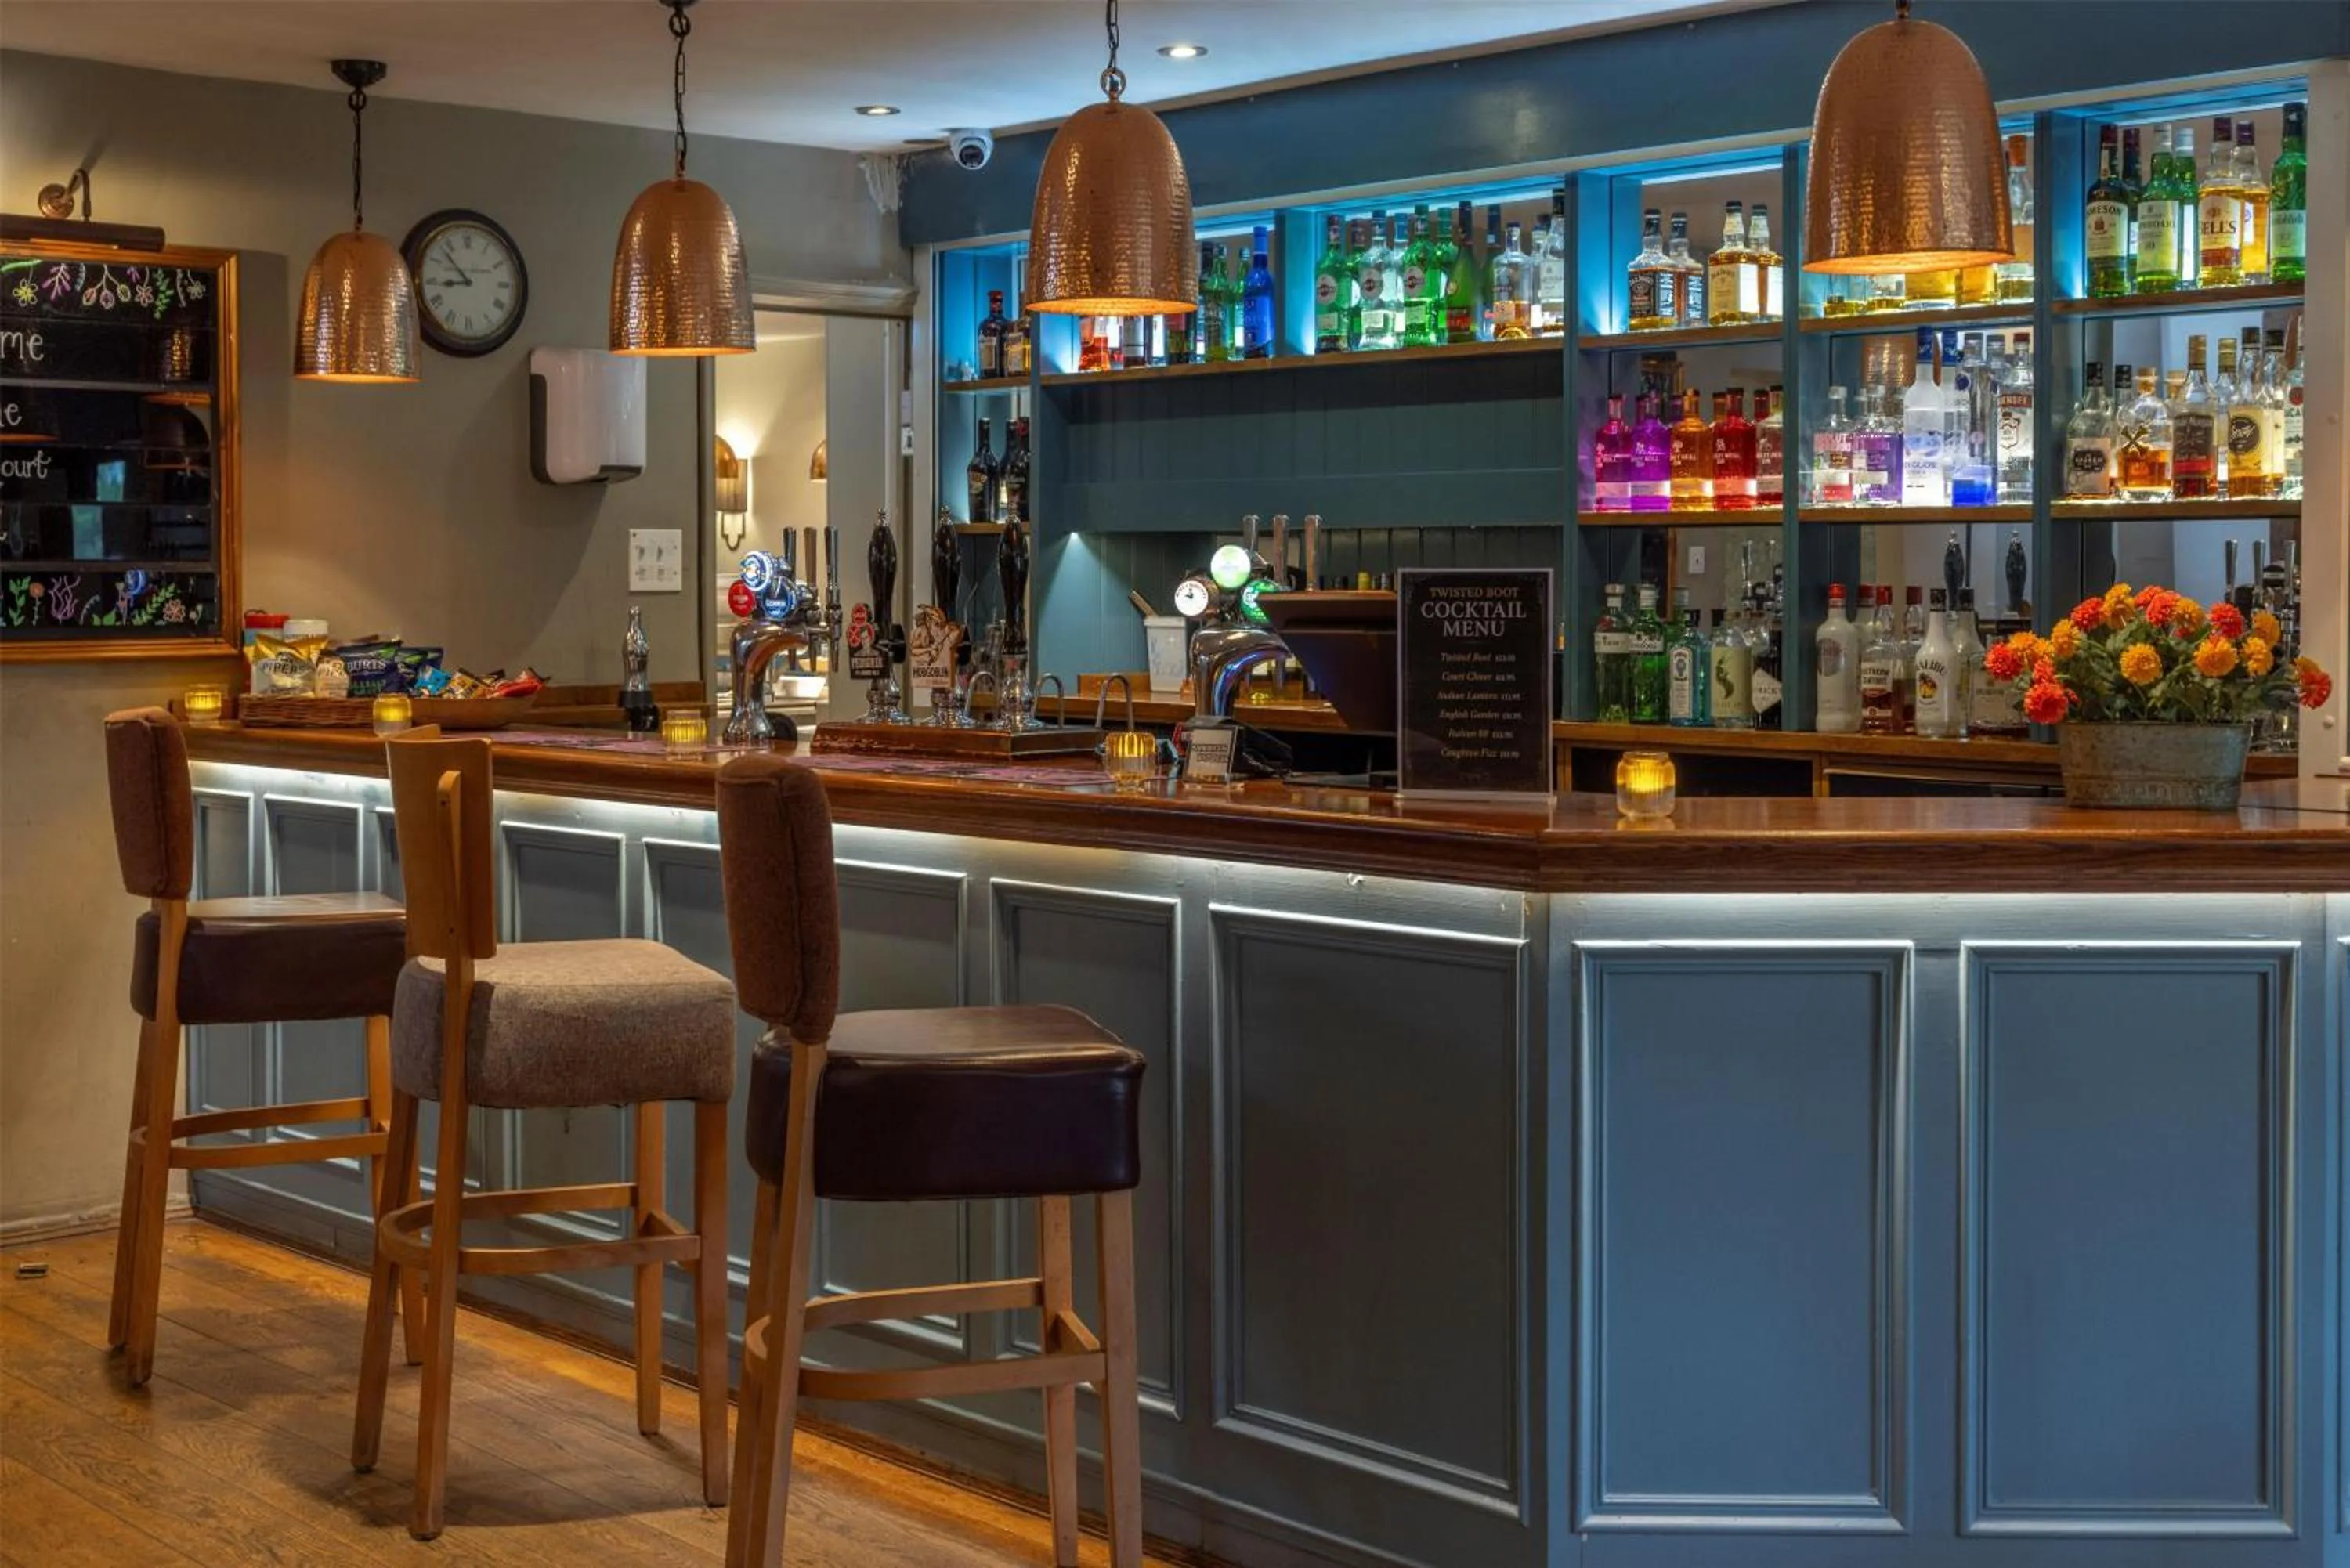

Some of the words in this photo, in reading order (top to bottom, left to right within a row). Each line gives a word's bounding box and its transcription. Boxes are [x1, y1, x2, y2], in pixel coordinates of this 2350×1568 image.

[1430, 587, 1483, 598] TWISTED
[1487, 587, 1519, 598] BOOT
[1421, 601, 1527, 618] COCKTAIL
[1443, 620, 1505, 637] MENU
[348, 659, 387, 671] BURTS
[913, 667, 949, 678] HOBGOBLIN
